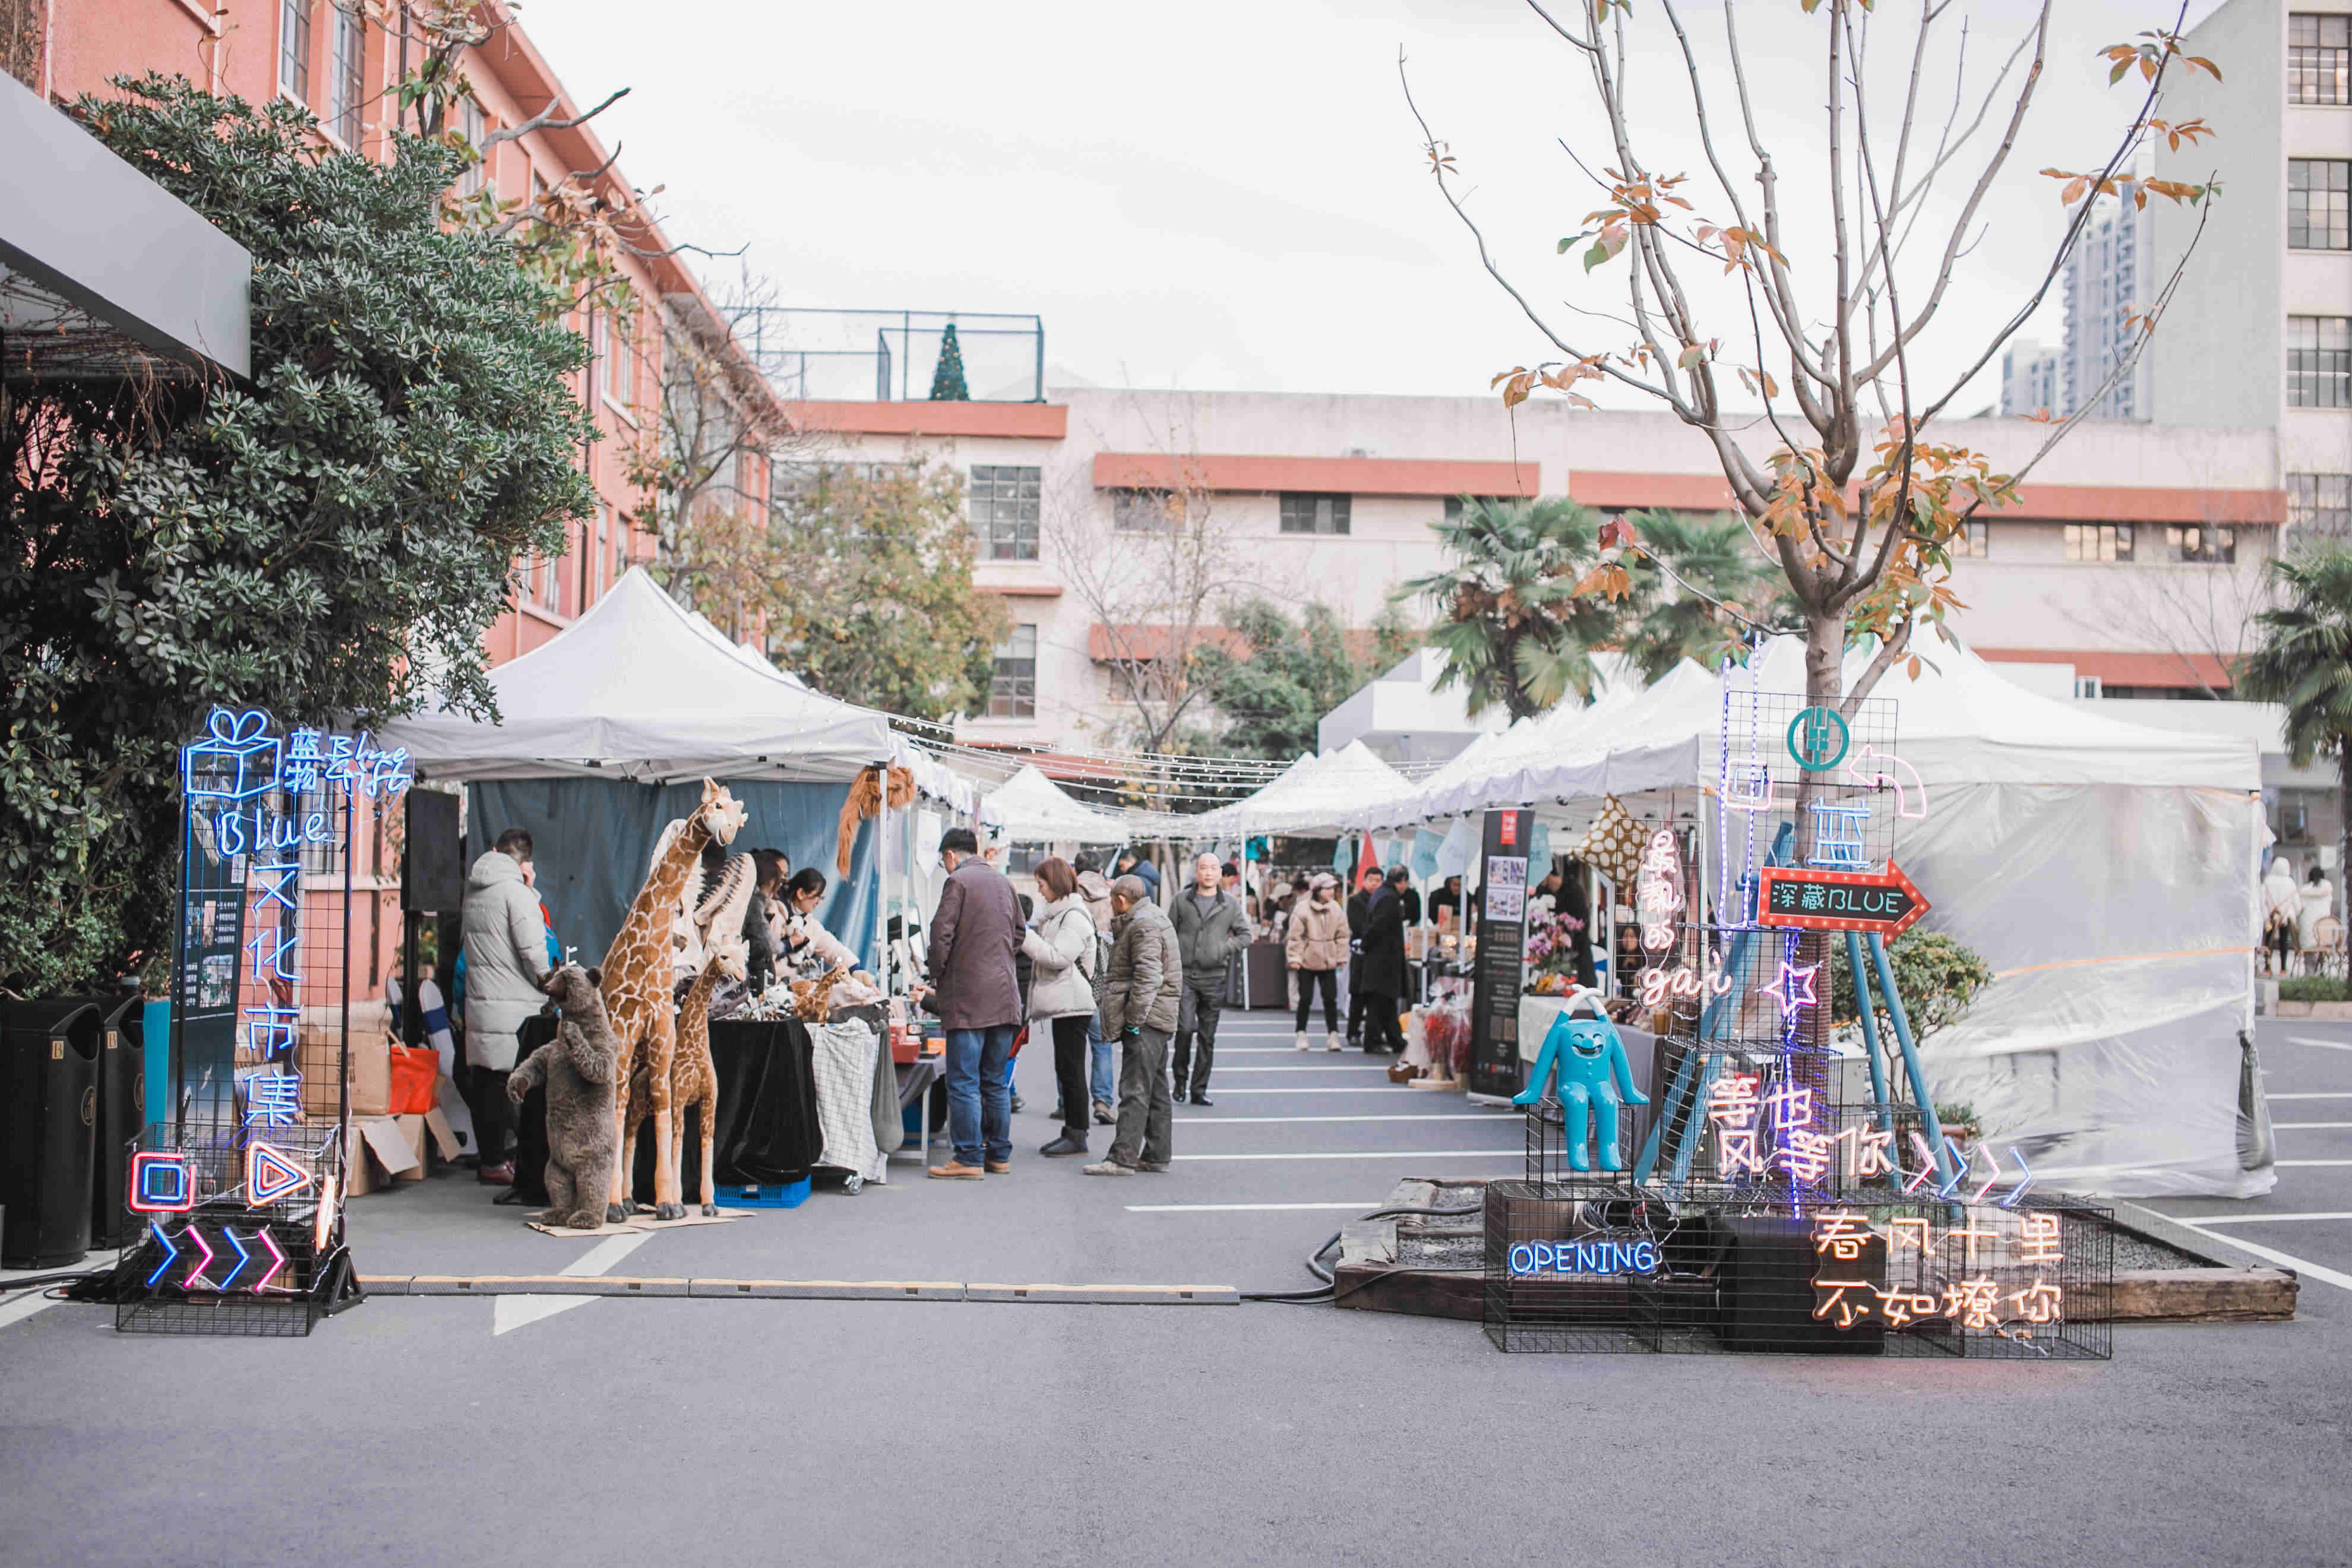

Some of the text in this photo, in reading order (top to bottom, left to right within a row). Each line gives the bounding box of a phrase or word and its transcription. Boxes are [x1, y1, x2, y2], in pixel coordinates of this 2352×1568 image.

[324, 731, 410, 763] Blue
[324, 758, 412, 798] Gift
[220, 808, 328, 855] Blue
[1643, 950, 1733, 1006] gai
[1815, 1208, 2064, 1260] 春风十里
[1510, 1240, 1656, 1273] OPENING
